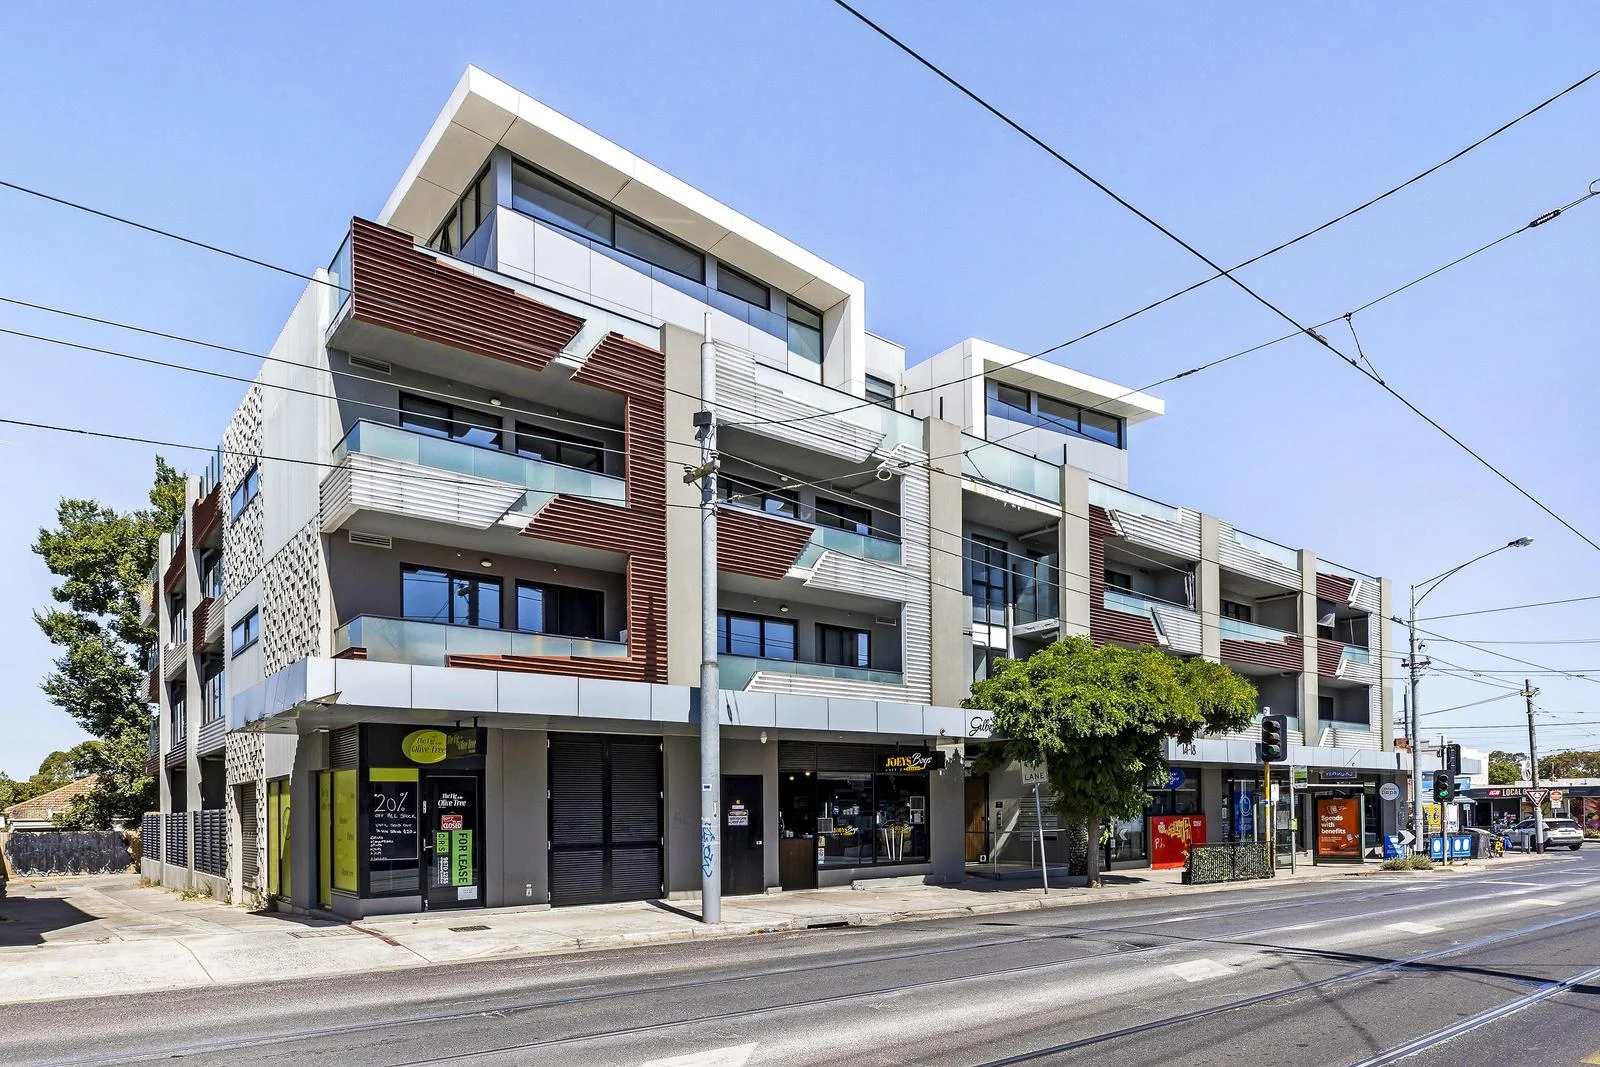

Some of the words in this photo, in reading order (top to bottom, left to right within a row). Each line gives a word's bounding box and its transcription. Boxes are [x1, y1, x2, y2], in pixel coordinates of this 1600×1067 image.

[885, 756, 912, 767] JOEYS
[1024, 773, 1045, 781] LANE
[1502, 788, 1521, 797] LOCAL
[437, 799, 453, 807] Olive
[453, 799, 467, 807] Tree
[458, 832, 468, 852] FOR
[458, 854, 468, 884] LEASE
